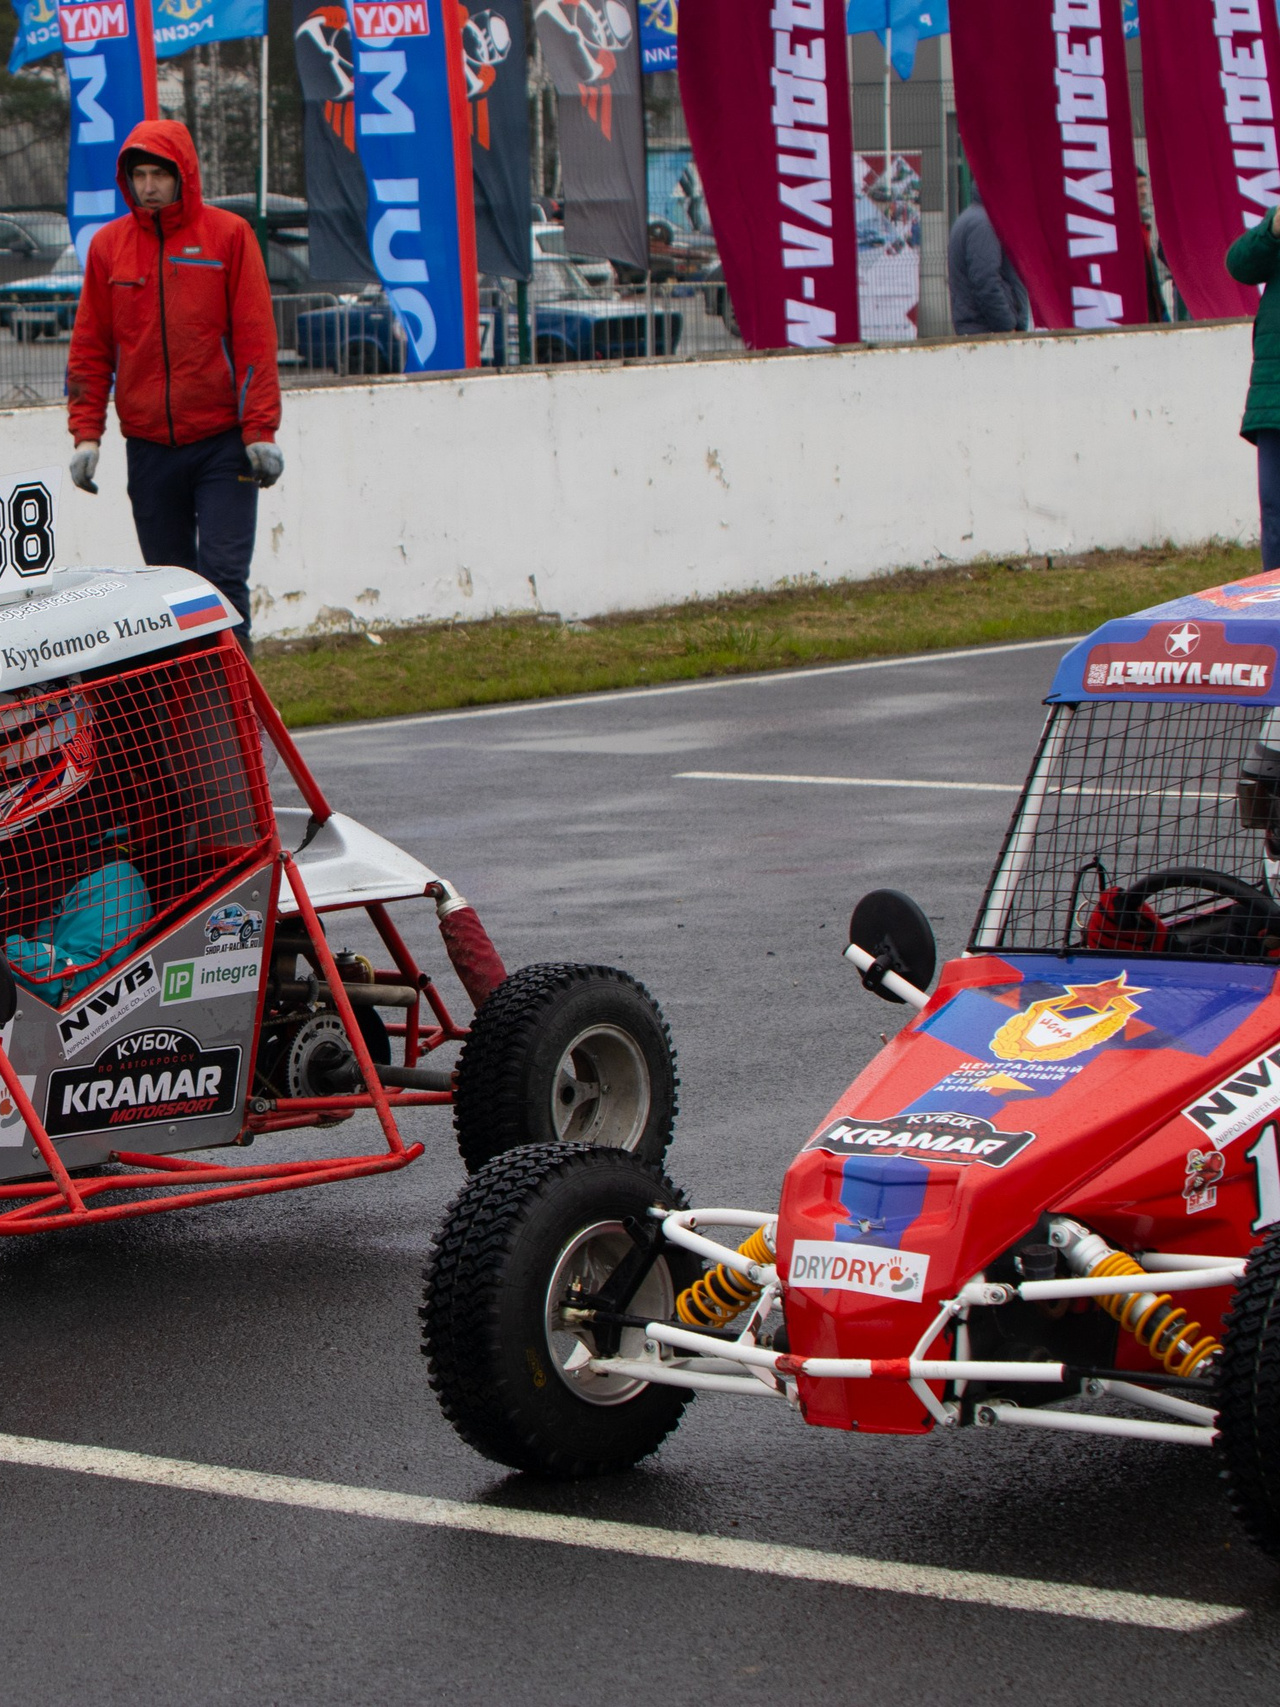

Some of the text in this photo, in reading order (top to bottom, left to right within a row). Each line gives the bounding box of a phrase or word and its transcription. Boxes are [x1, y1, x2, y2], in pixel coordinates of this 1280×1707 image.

[1, 611, 173, 670] Курбатов Илья
[1106, 661, 1268, 687] ДЭДПУЛ-МСК
[169, 961, 258, 994] IP integra
[59, 961, 154, 1044] NWB
[66, 1036, 90, 1055] NIPPON
[90, 1020, 110, 1037] WIPER
[110, 1006, 130, 1023] BLADE
[117, 1033, 183, 1060] КУБОК
[951, 1070, 1066, 1081] СПОРТИВНЫЙ
[960, 1062, 1084, 1074] ЦЕНТРАЛЬНЫЙ
[61, 1065, 222, 1115] KRAMAR
[932, 1085, 993, 1093] АРМИИ
[109, 1097, 219, 1124] MOTORSPORT
[1215, 1120, 1247, 1145] NIPPON
[1245, 1101, 1272, 1122] WIPER
[827, 1125, 1007, 1156] KRAMAR
[793, 1255, 886, 1286] DRYDRY
